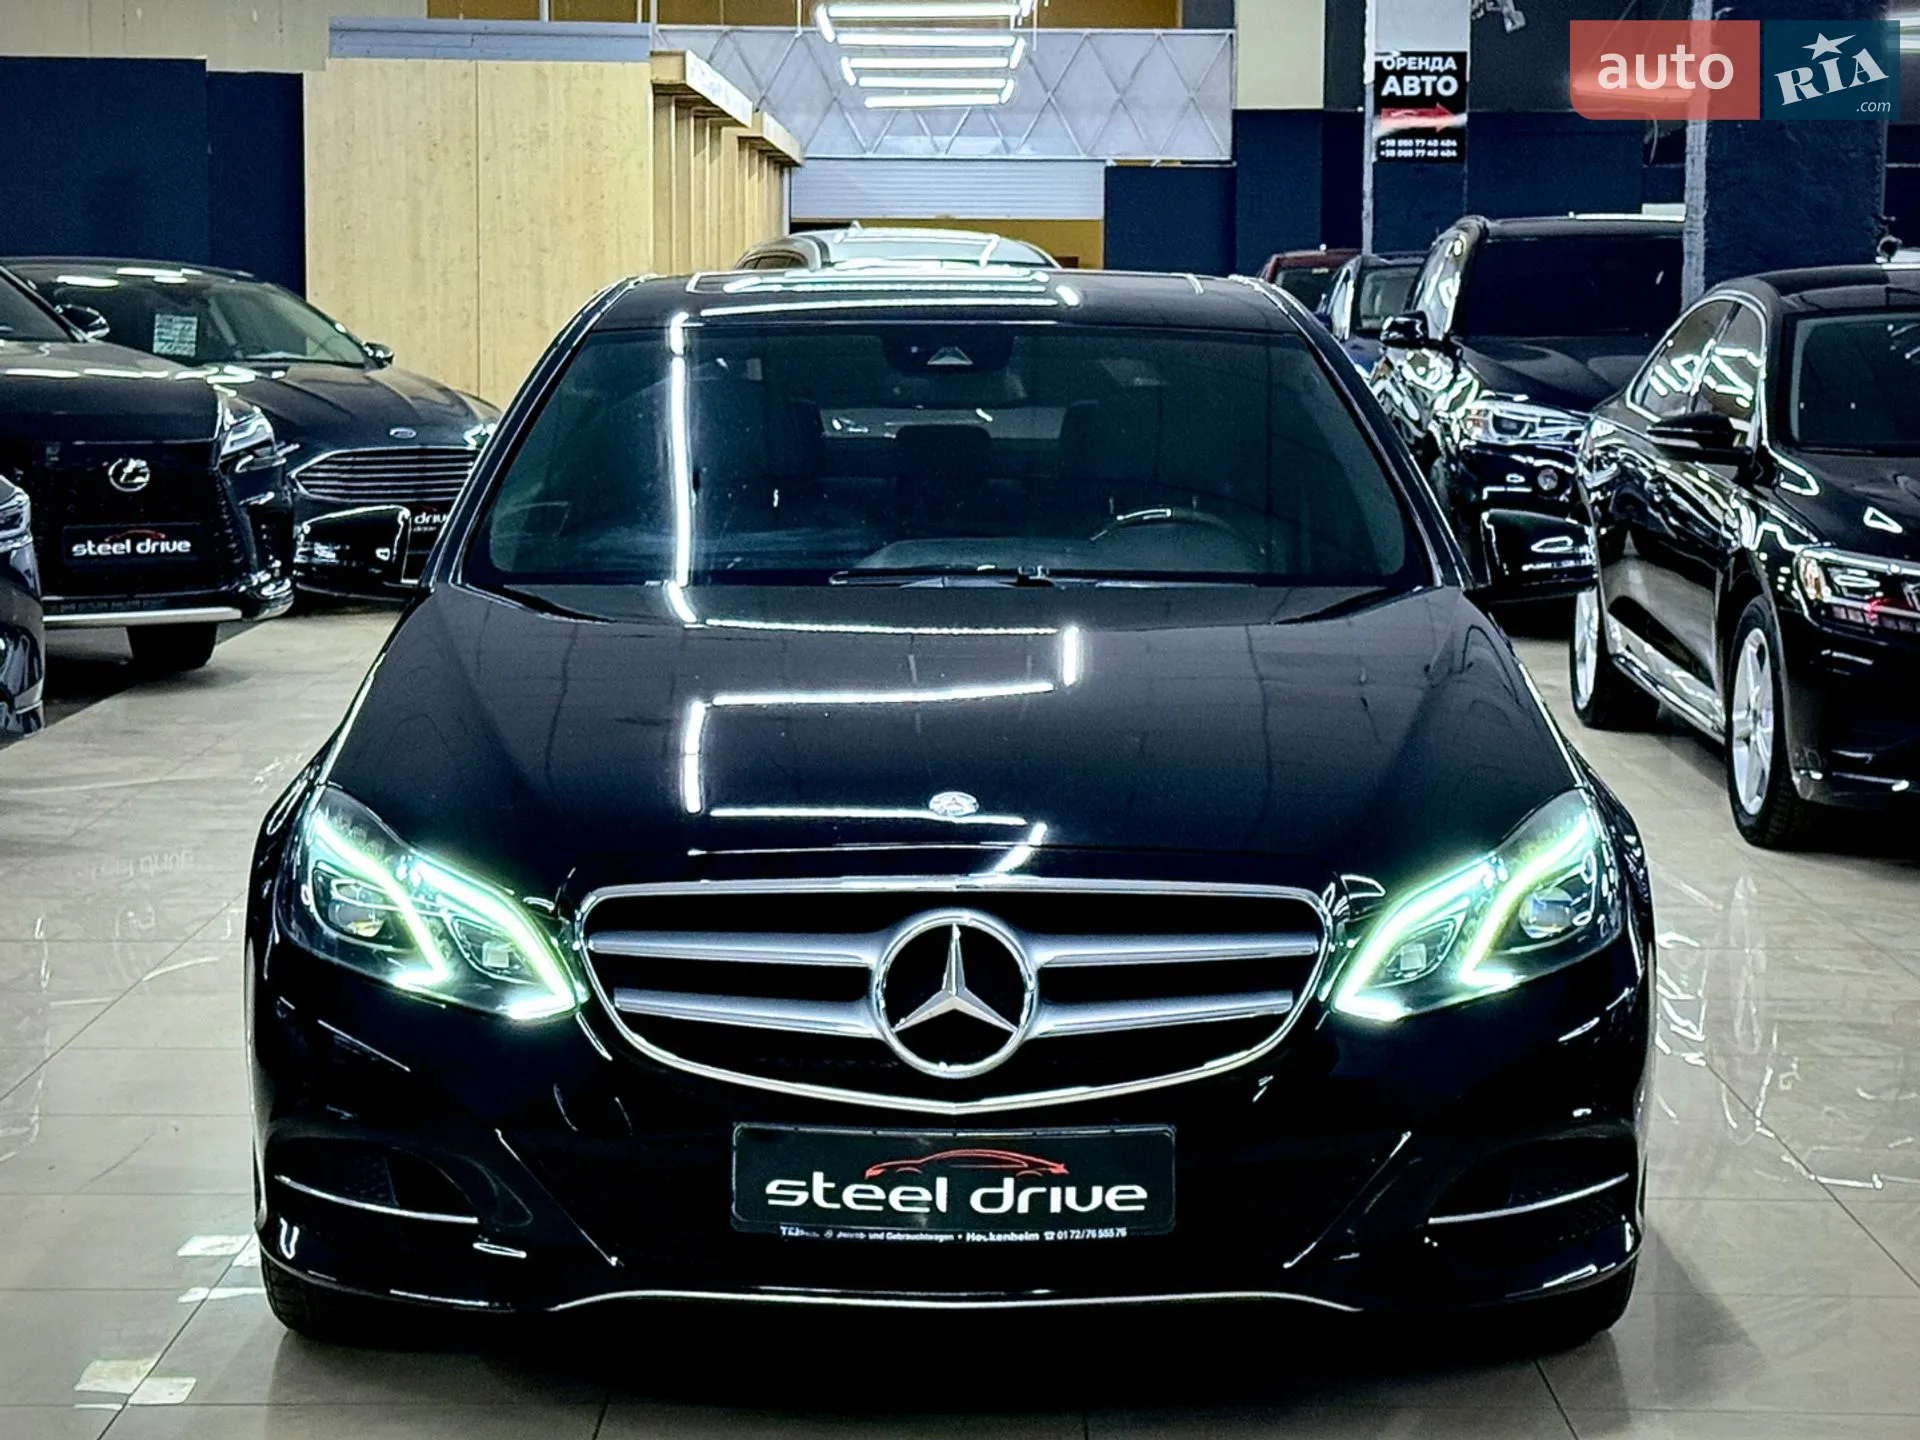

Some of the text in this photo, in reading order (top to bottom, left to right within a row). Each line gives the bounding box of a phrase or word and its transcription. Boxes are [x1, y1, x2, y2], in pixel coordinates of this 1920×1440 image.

[1382, 56, 1457, 72] ОРЕНДА
[1381, 75, 1459, 97] АВТО
[71, 538, 191, 557] steel drive
[765, 1171, 1148, 1215] steel drive
